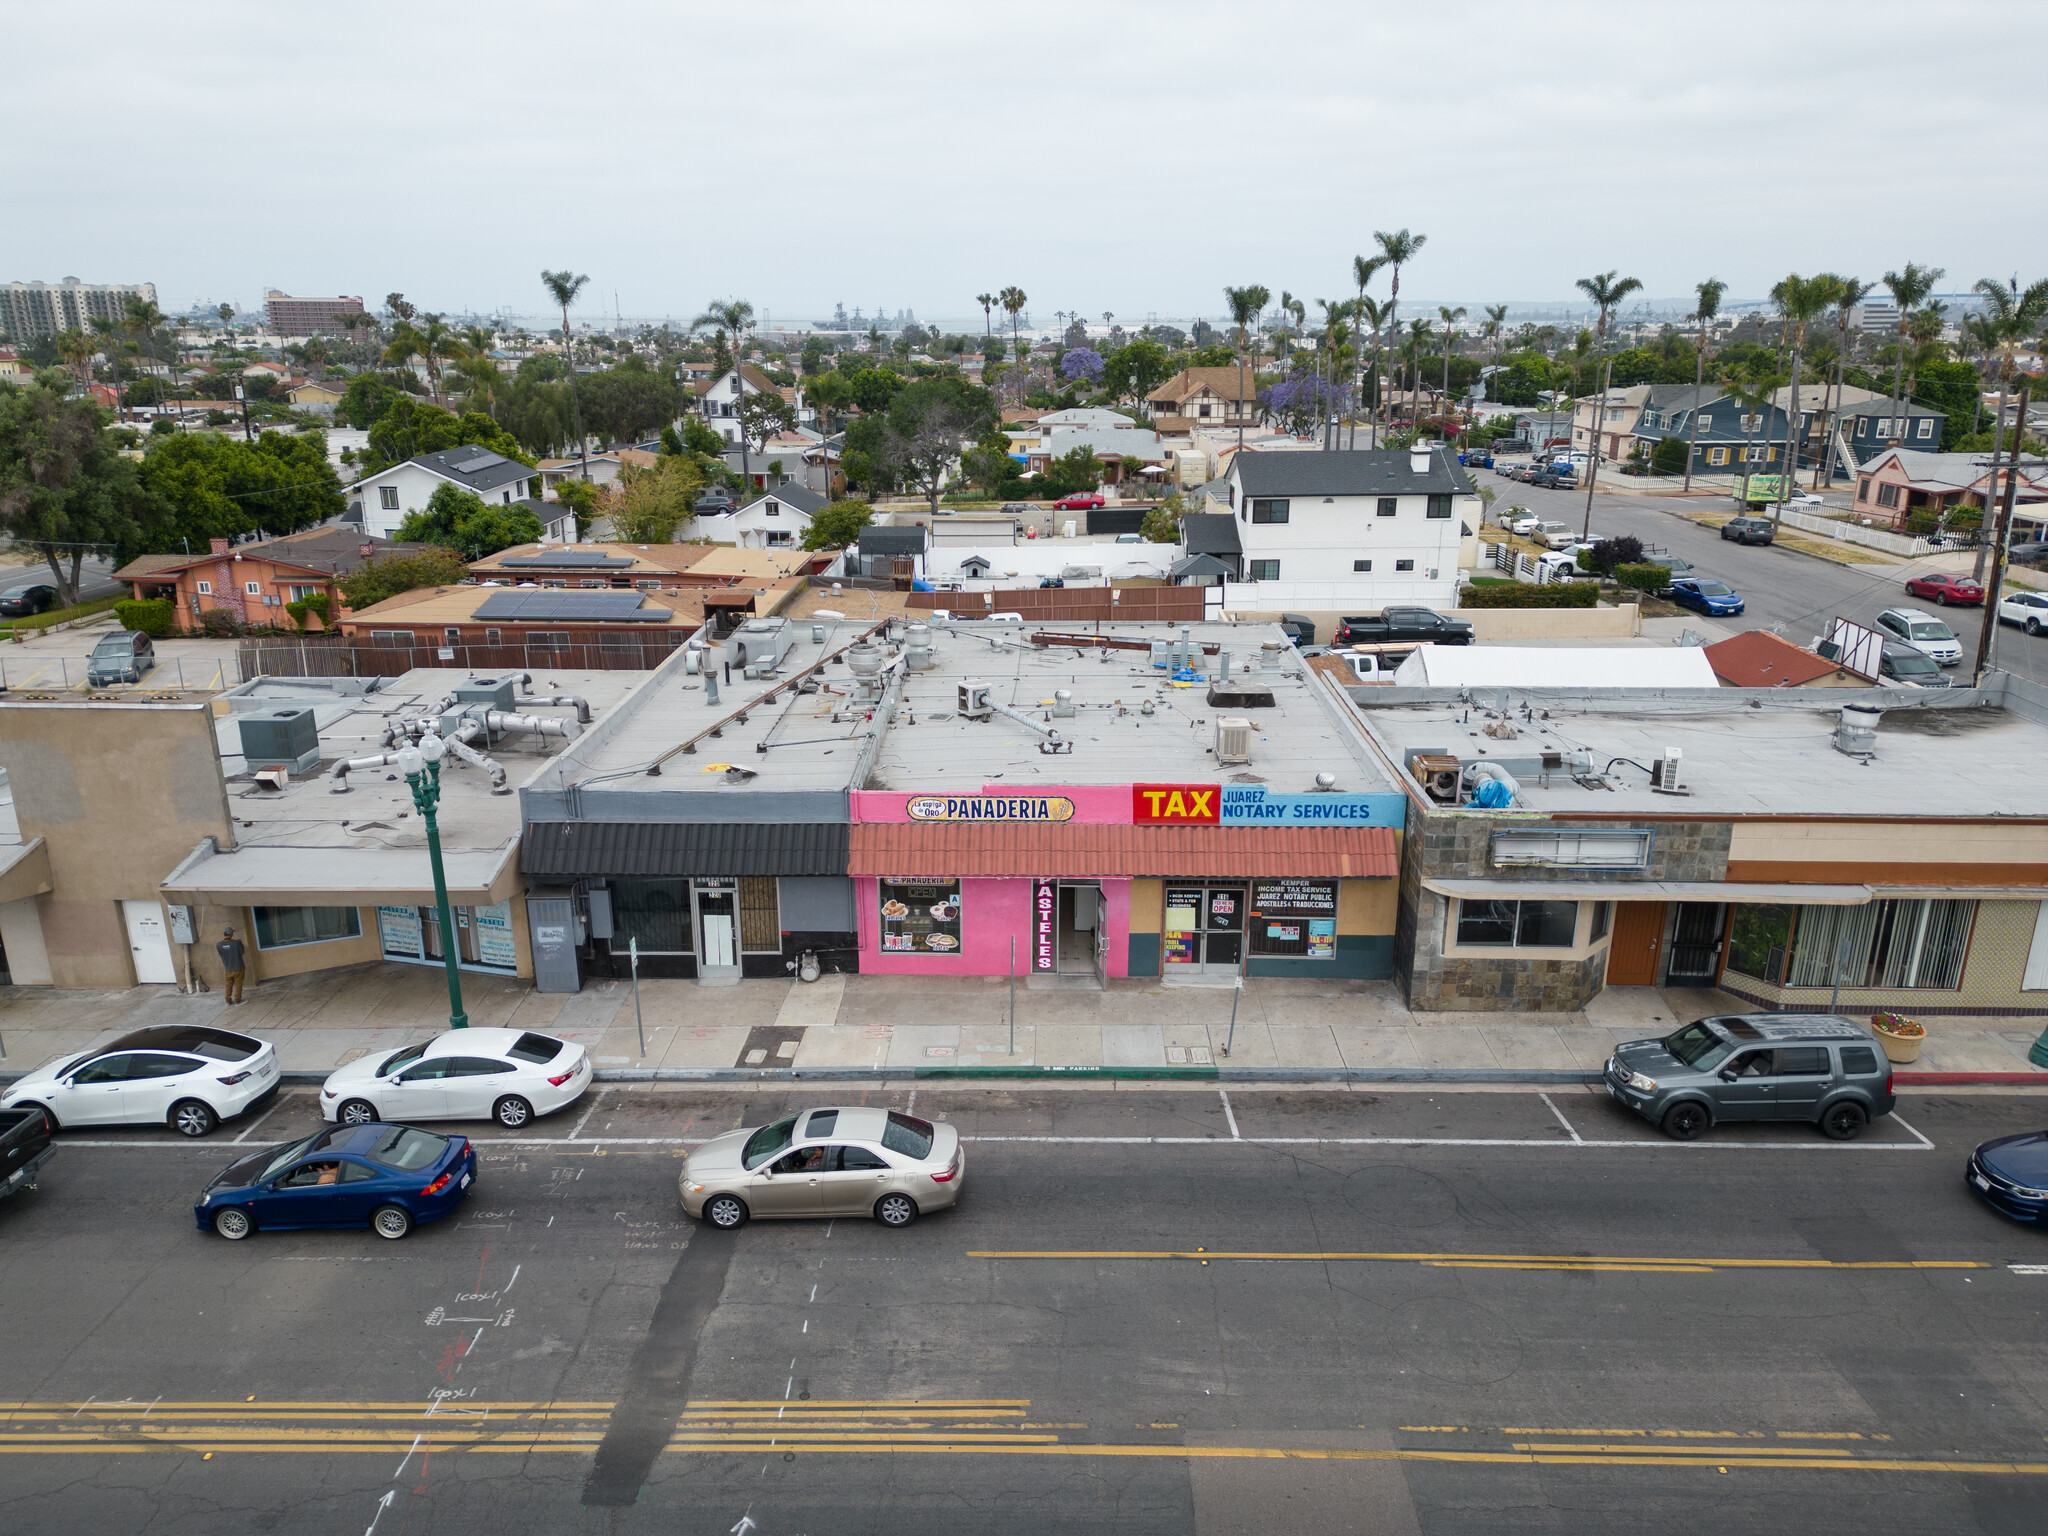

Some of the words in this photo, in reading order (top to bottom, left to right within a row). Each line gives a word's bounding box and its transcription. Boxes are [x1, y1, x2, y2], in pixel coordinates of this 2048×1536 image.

[1143, 791, 1213, 817] TAX
[1223, 791, 1264, 803] JUAREZ
[922, 801, 942, 809] espiga
[947, 799, 1049, 818] PANADERIA
[1223, 805, 1287, 818] NOTARY
[1293, 804, 1370, 819] SERVICES
[909, 887, 935, 897] OPEN
[1038, 878, 1053, 968] PASTELES
